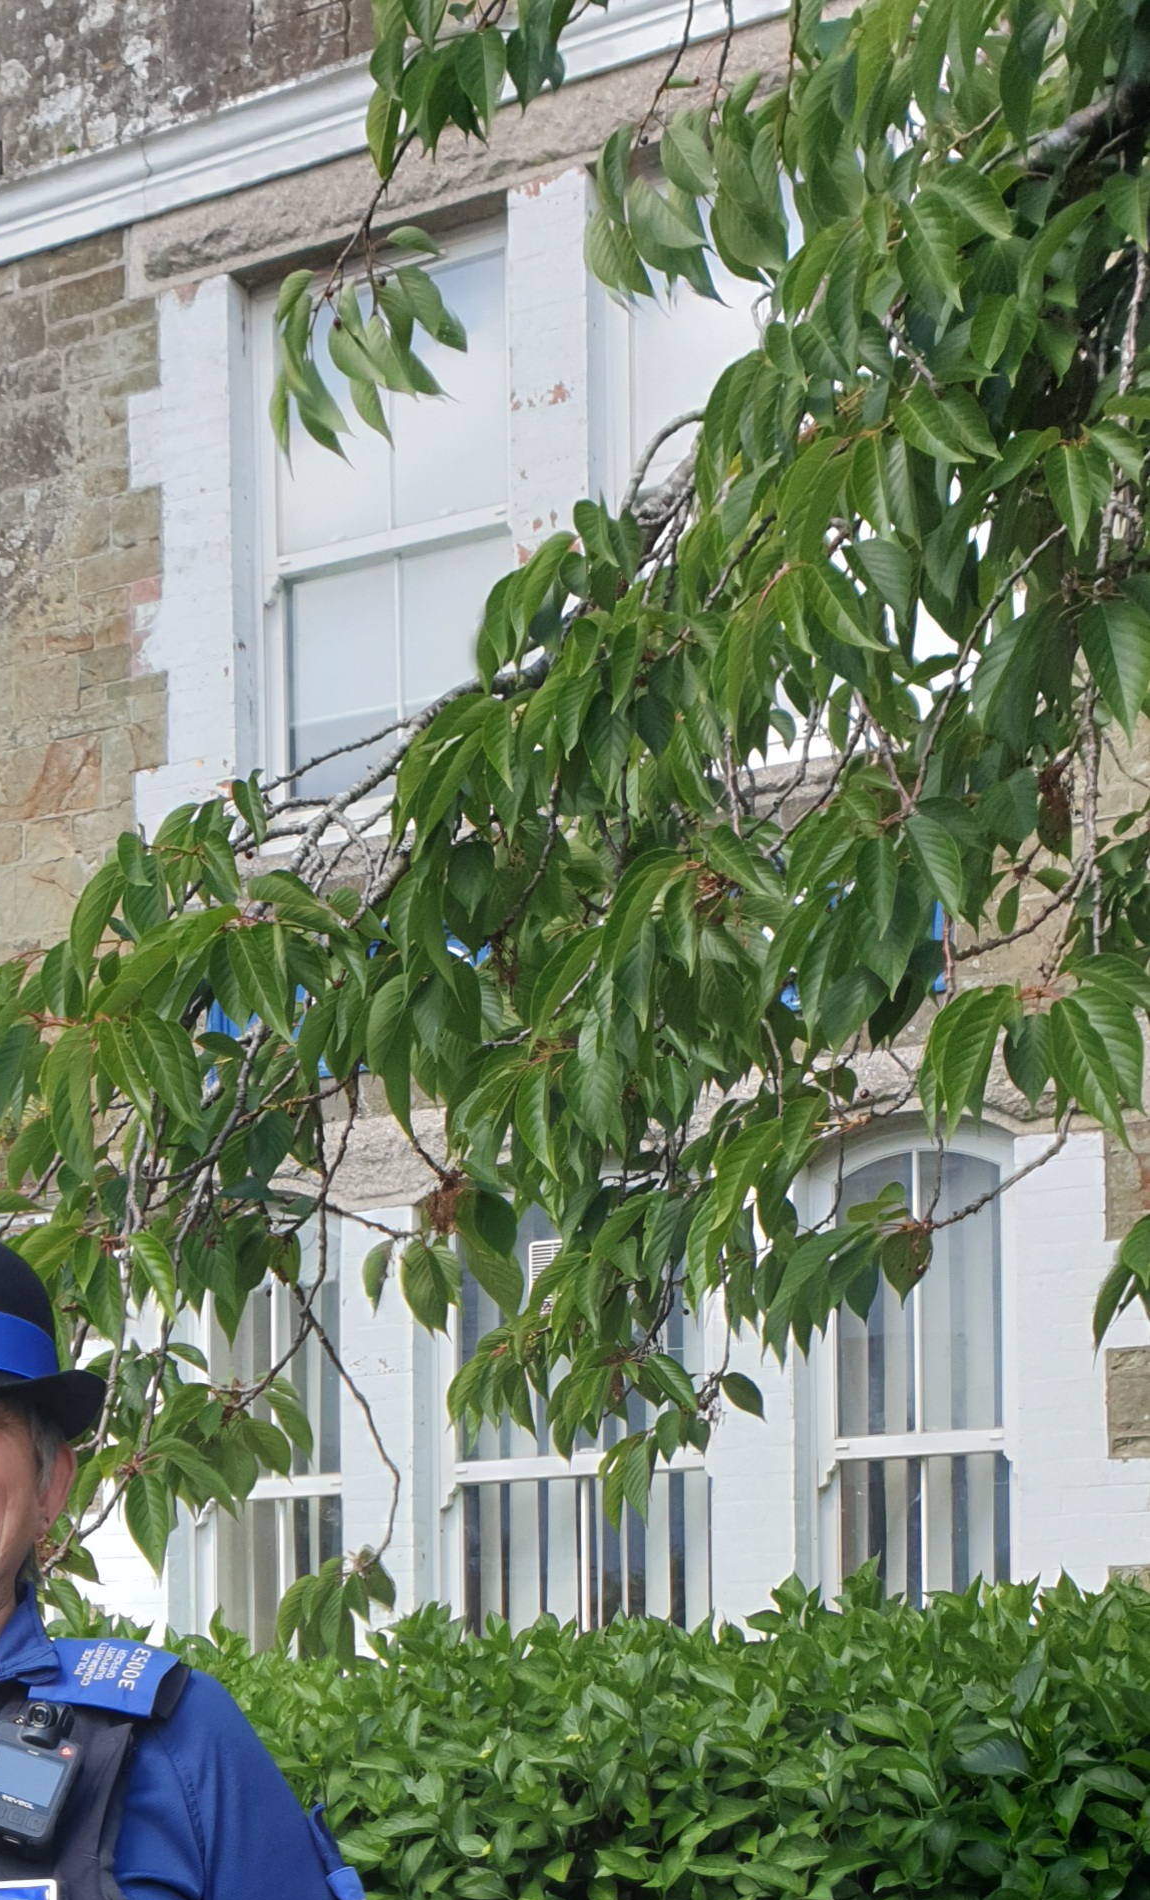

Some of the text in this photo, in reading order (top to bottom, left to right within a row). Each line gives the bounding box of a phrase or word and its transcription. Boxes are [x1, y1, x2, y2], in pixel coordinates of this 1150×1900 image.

[73, 1648, 95, 1675] POLICE
[93, 1645, 118, 1680] SUPPORT
[105, 1649, 129, 1679] OFFICER
[117, 1647, 152, 1691] 30053
